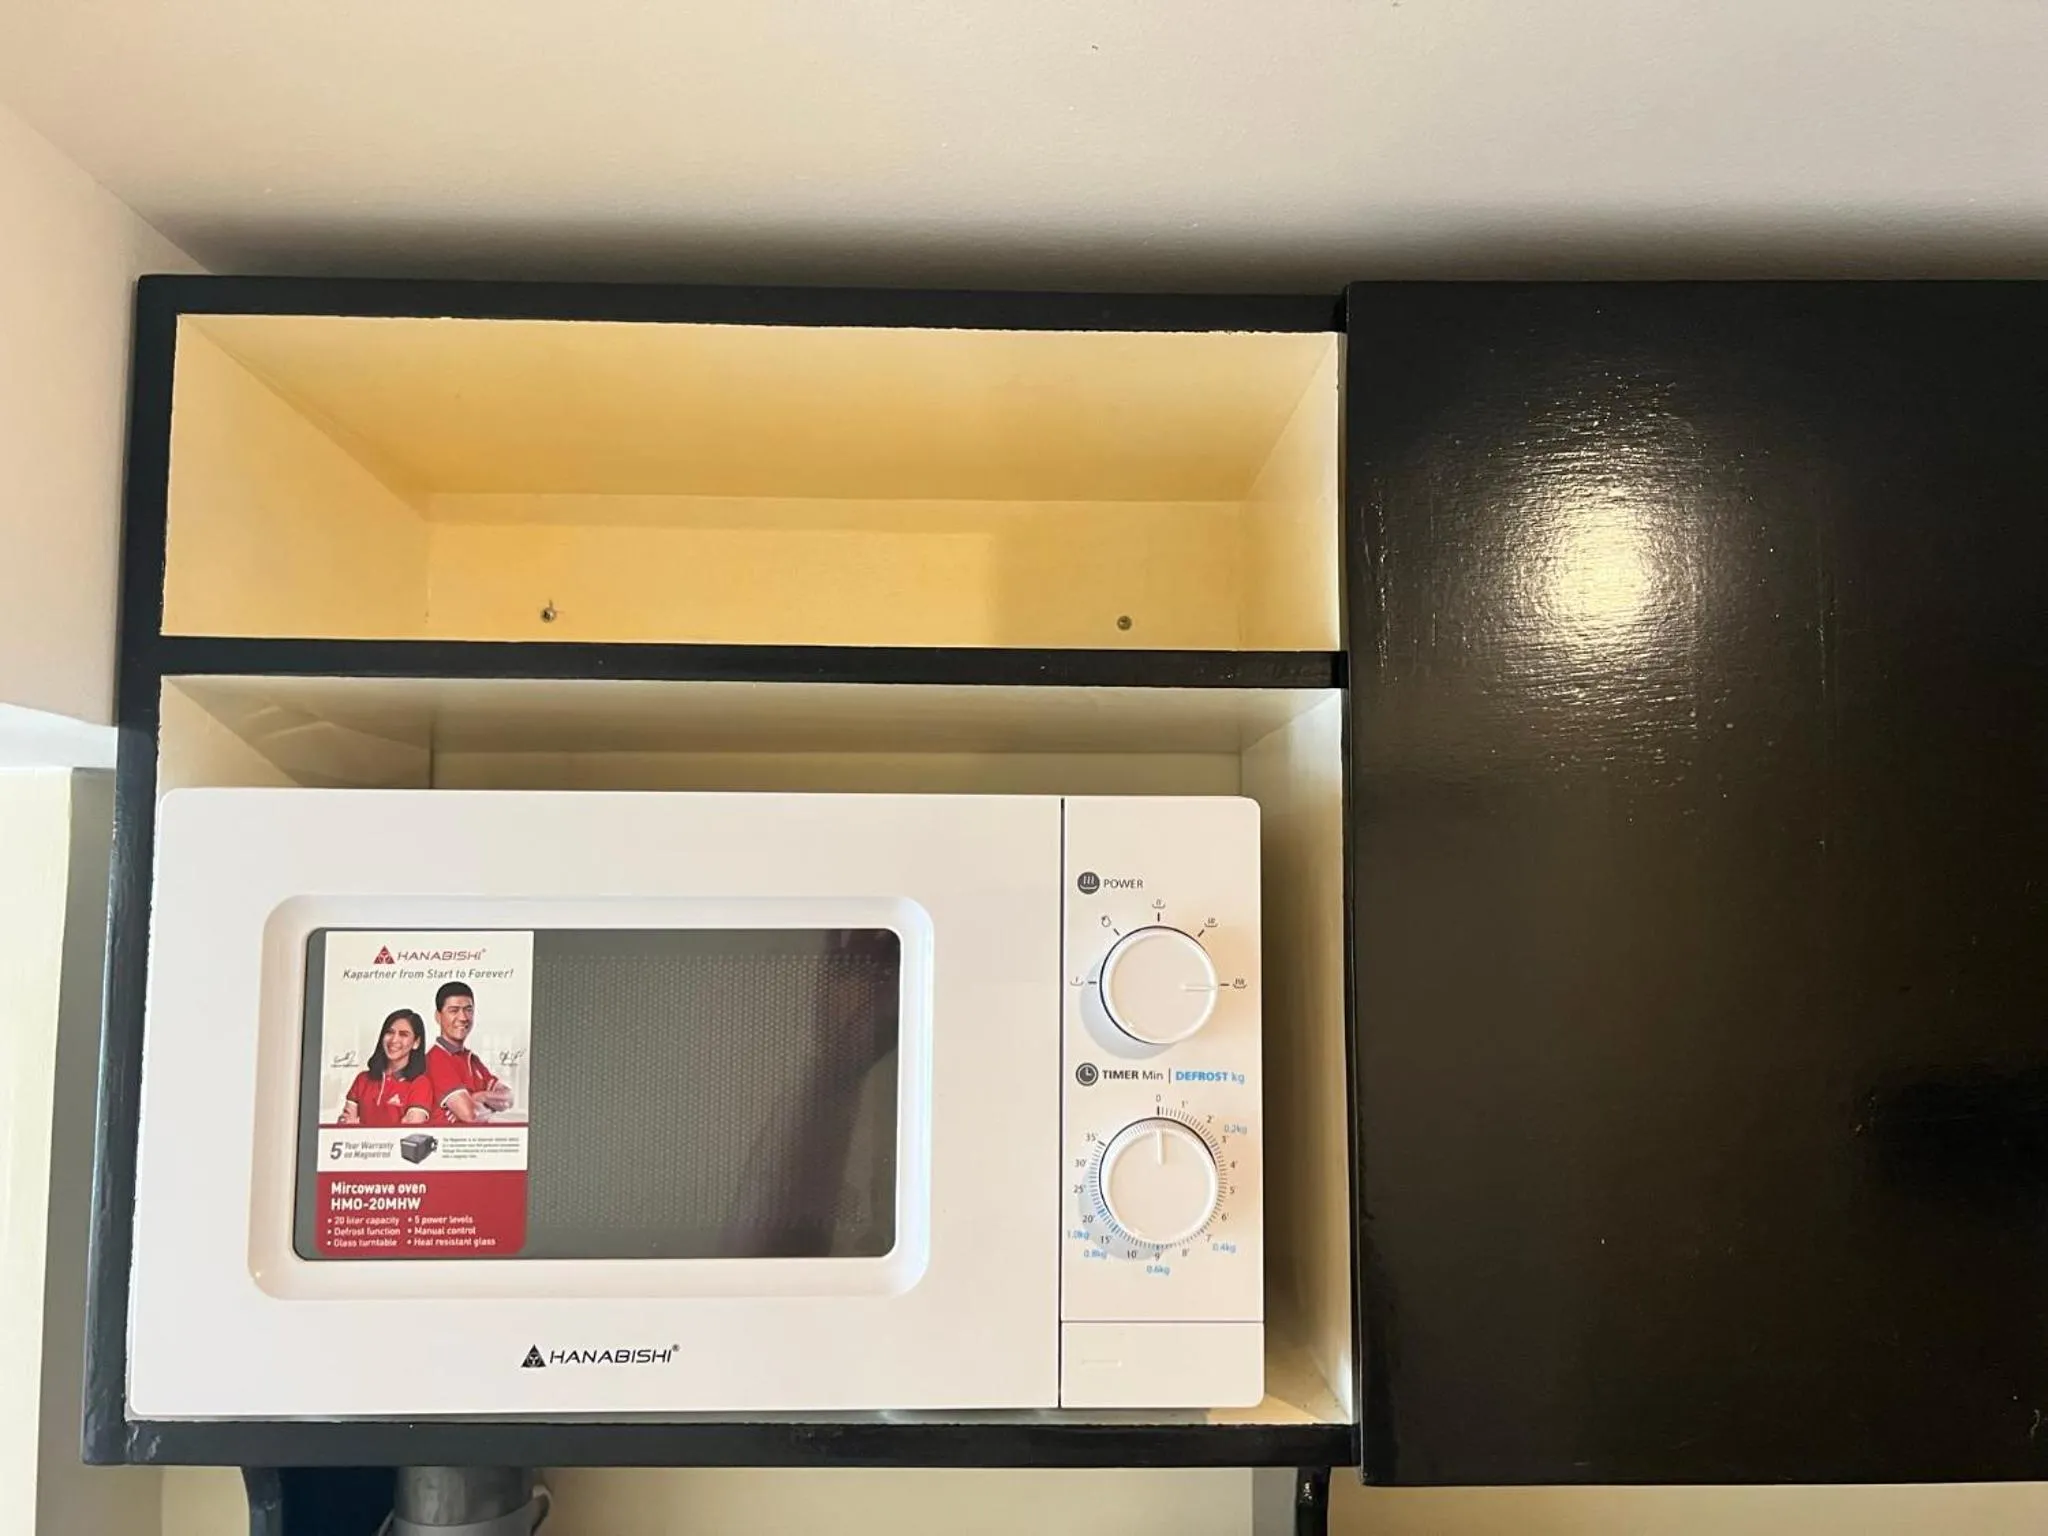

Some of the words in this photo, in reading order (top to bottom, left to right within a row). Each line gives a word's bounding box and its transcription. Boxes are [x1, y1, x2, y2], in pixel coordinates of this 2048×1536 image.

[1103, 878, 1144, 889] POWER
[343, 969, 397, 980] Kapartner
[400, 969, 424, 979] from
[427, 969, 453, 979] Start
[455, 969, 467, 979] to
[468, 969, 514, 979] Forever!
[1102, 1069, 1139, 1080] TIMER
[1142, 1069, 1164, 1080] Min
[1175, 1071, 1228, 1082] DEFROST
[1231, 1071, 1246, 1085] kg
[330, 1142, 343, 1160] 5
[361, 1142, 394, 1151] Warranty
[331, 1182, 395, 1194] Mircowave
[398, 1183, 426, 1194] oven
[331, 1197, 421, 1211] HMO-20MHW
[334, 1216, 345, 1225] 20
[365, 1217, 400, 1227] capacity
[421, 1217, 447, 1226] power
[449, 1215, 473, 1224] levels
[334, 1228, 365, 1237] Defrost
[366, 1228, 400, 1236] function
[414, 1227, 445, 1235] Manual
[447, 1227, 476, 1235] control
[334, 1239, 357, 1248] Glass
[359, 1238, 397, 1247] turntable
[414, 1238, 434, 1246] Heat
[435, 1238, 472, 1246] resistant
[474, 1238, 496, 1248] glass
